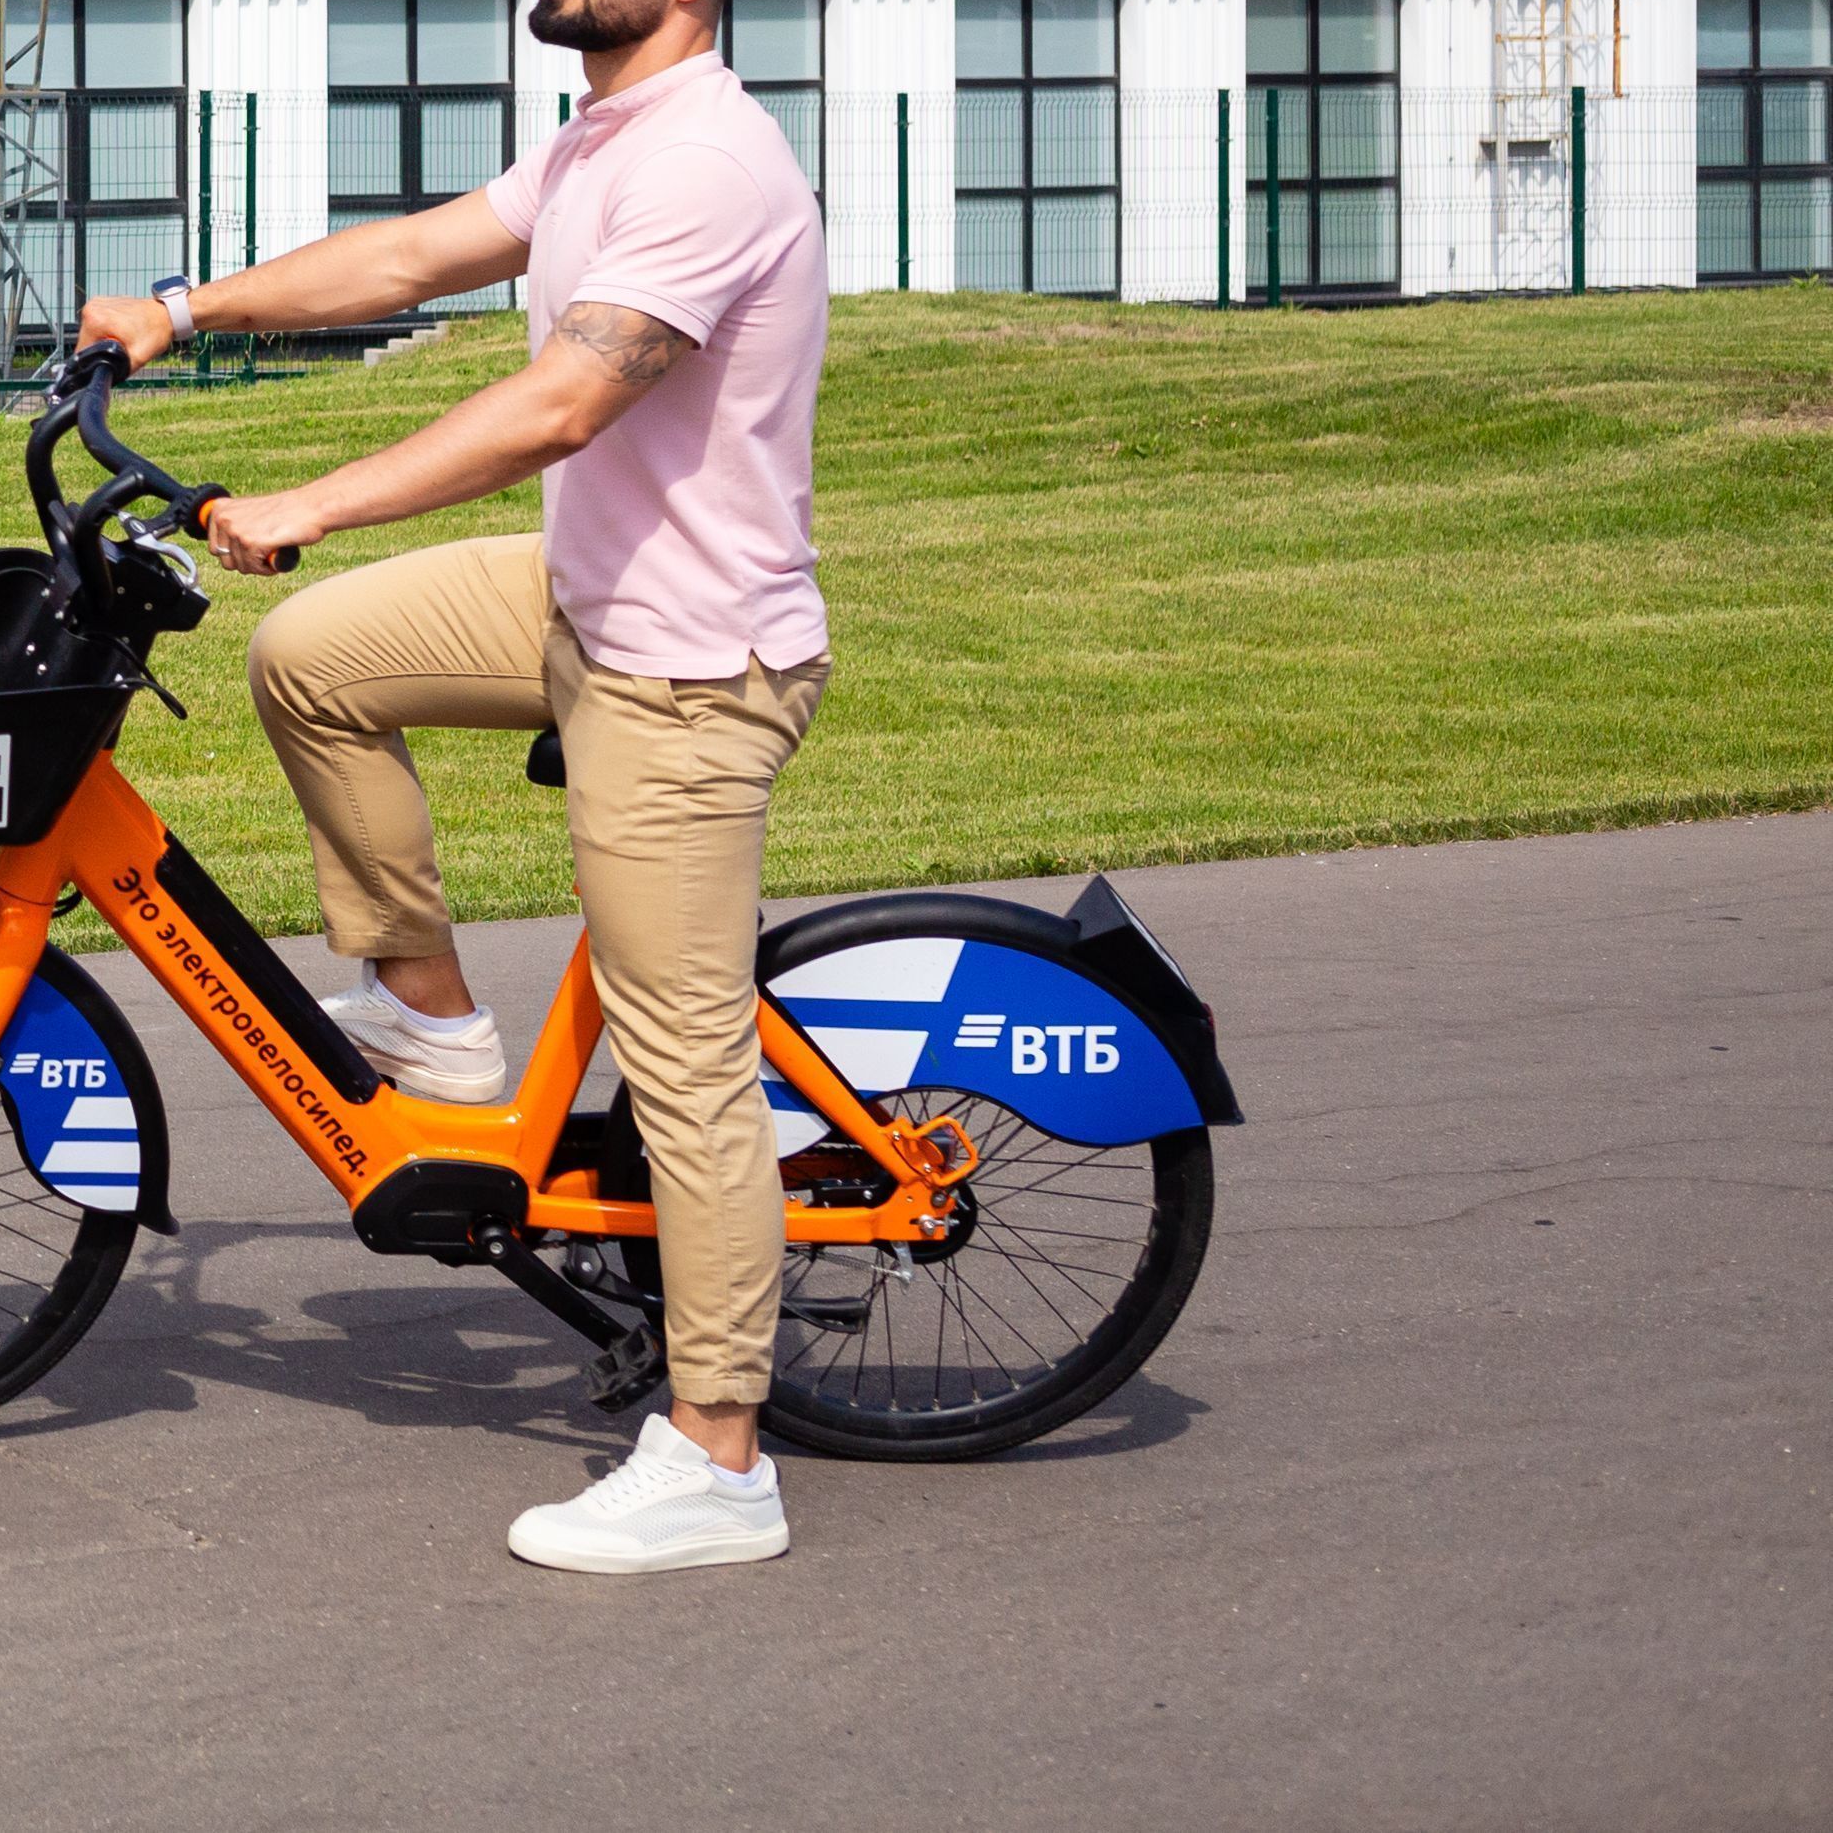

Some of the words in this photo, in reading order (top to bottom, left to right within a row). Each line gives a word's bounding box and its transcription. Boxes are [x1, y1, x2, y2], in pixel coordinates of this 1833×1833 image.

[113, 867, 160, 922] Это
[156, 924, 368, 1178] электровелосипед.
[40, 1059, 107, 1088] ВТБ
[1011, 1025, 1121, 1075] ВТБ
